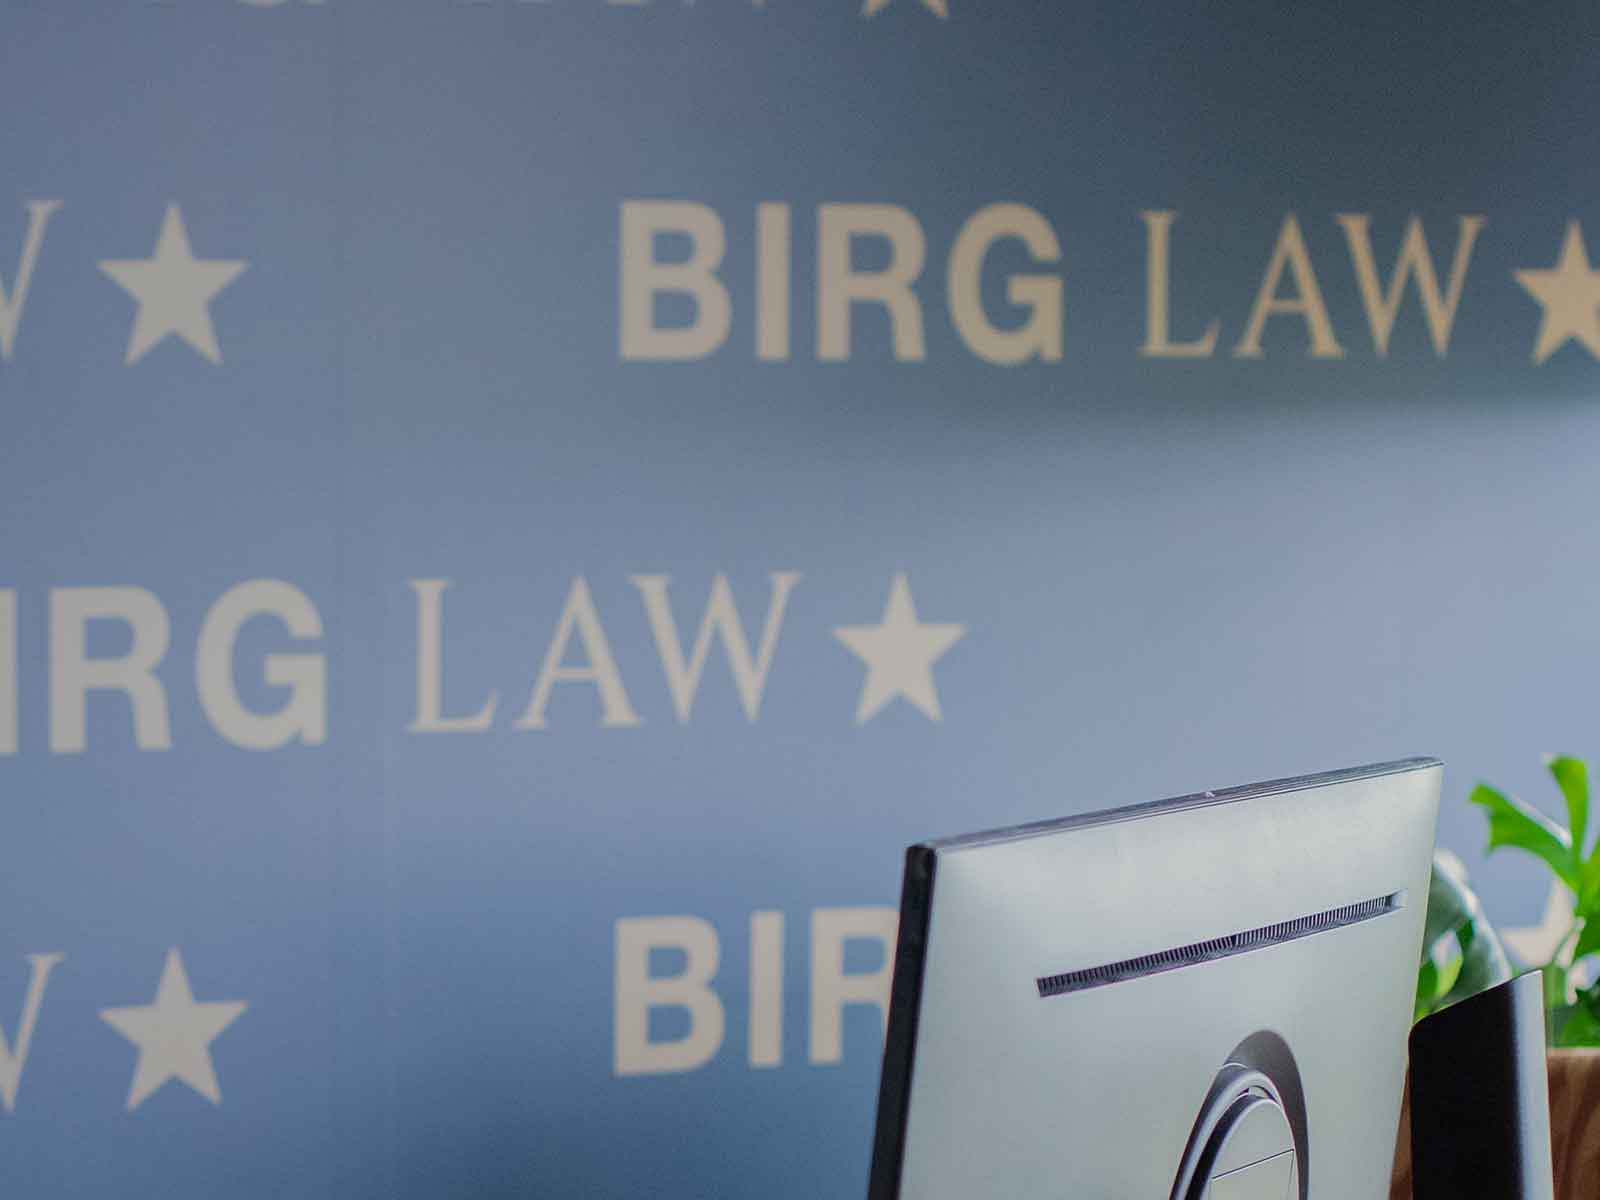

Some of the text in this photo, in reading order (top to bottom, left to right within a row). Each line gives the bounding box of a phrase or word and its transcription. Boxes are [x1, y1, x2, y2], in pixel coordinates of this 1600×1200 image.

[620, 199, 1485, 364] BIRG LAW
[412, 573, 798, 734] LAW
